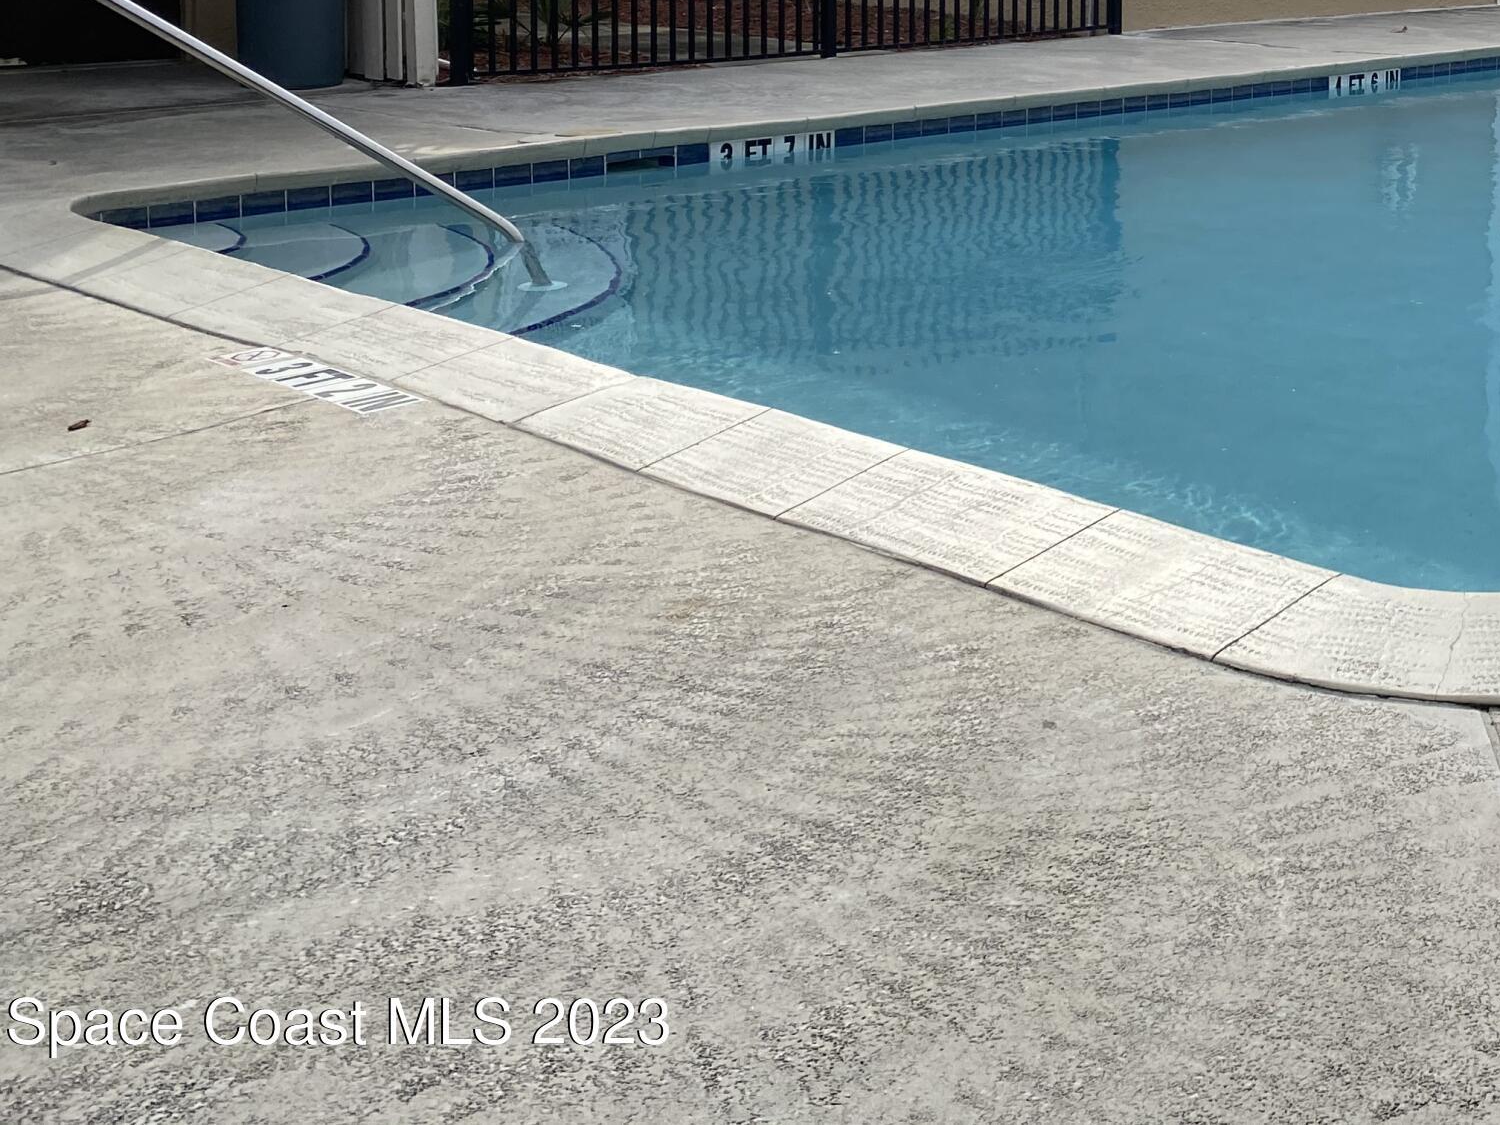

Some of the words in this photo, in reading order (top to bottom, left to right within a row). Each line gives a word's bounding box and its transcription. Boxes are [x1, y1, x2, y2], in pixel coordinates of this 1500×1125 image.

[745, 137, 772, 158] FT
[809, 132, 831, 151] IN
[255, 362, 313, 375] 3
[275, 369, 355, 387] FT
[314, 383, 378, 398] 2
[340, 391, 420, 412] IN
